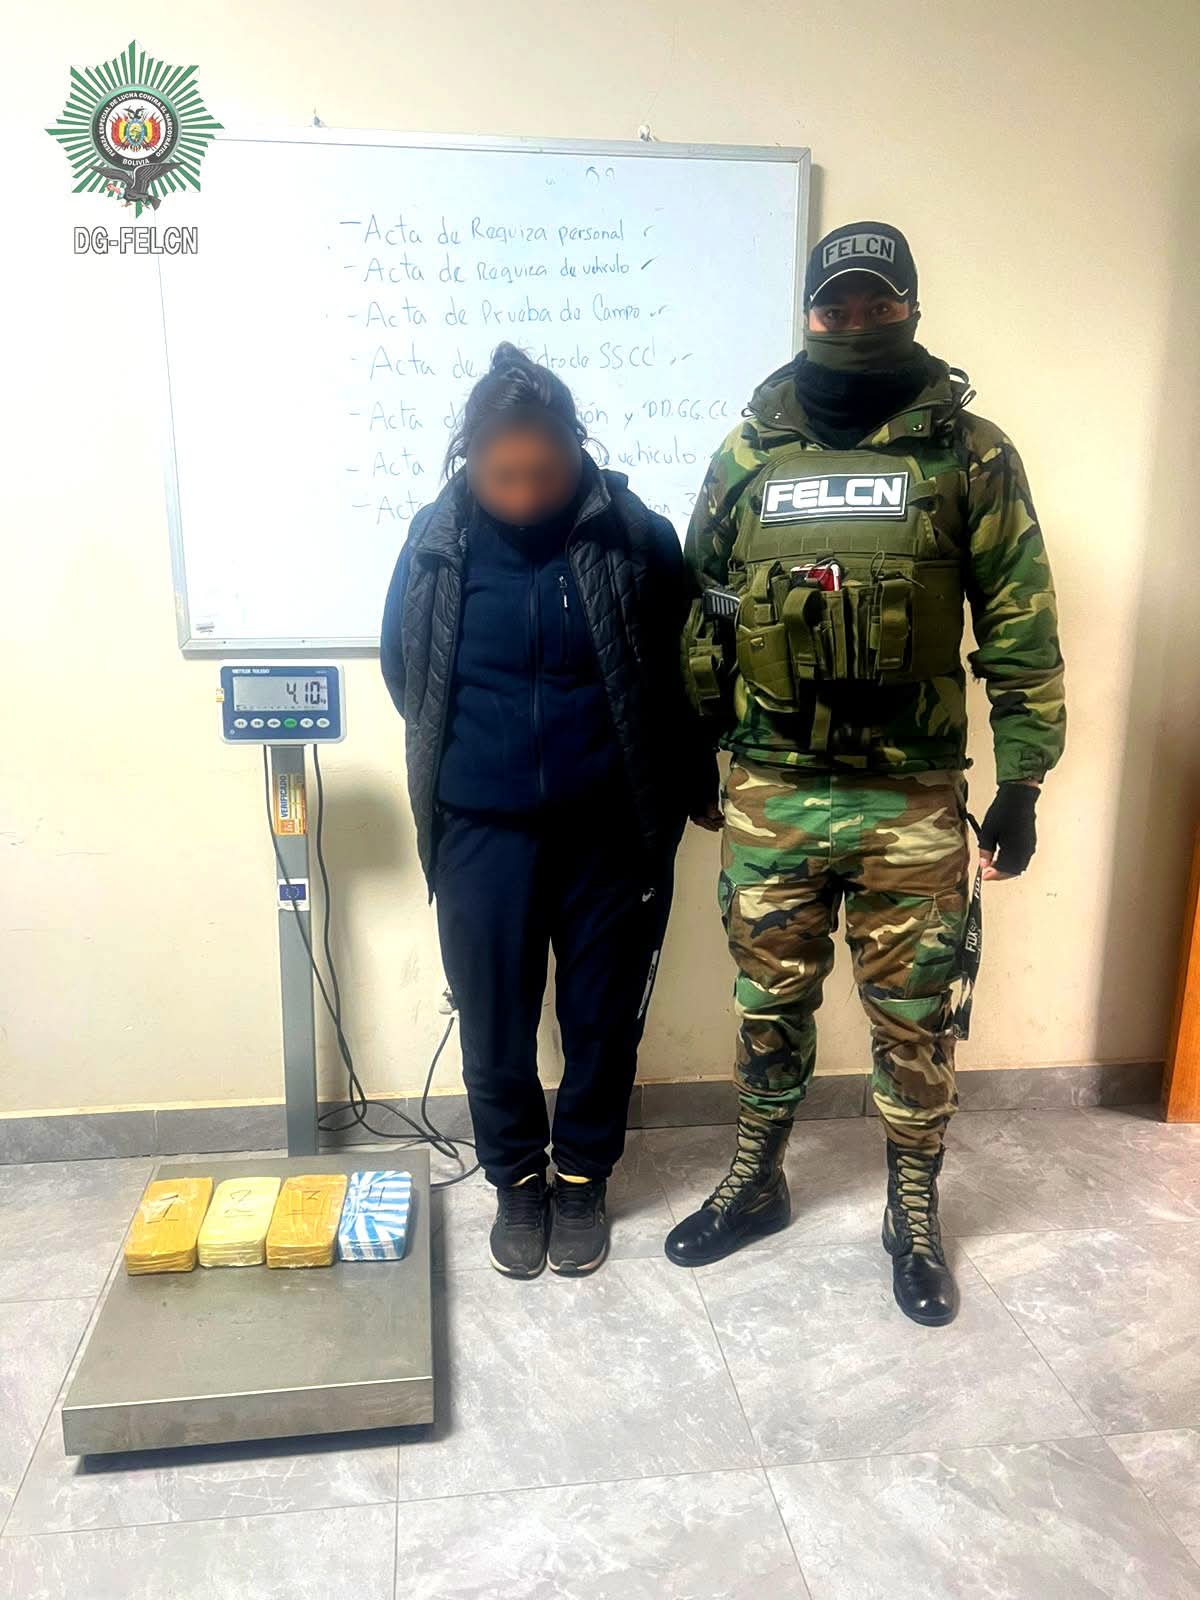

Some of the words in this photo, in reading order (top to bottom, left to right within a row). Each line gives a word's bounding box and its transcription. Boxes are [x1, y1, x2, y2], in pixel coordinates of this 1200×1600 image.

[364, 214, 422, 246] Acta
[437, 216, 461, 245] de
[558, 219, 624, 247] personal
[363, 252, 424, 283] Acta
[439, 252, 465, 283] de
[560, 257, 577, 277] de
[825, 237, 892, 264] FELCN
[366, 297, 427, 328] Acta
[445, 296, 468, 326] de
[481, 296, 552, 324] Prueba
[592, 293, 641, 322] Campo
[369, 341, 436, 381] Acta
[369, 400, 423, 432] Acta
[372, 448, 425, 478] Acta
[617, 434, 697, 466] vehiculo
[766, 477, 903, 512] FELCN
[280, 775, 289, 818] VERIFICADO
[965, 929, 978, 953] FOX
